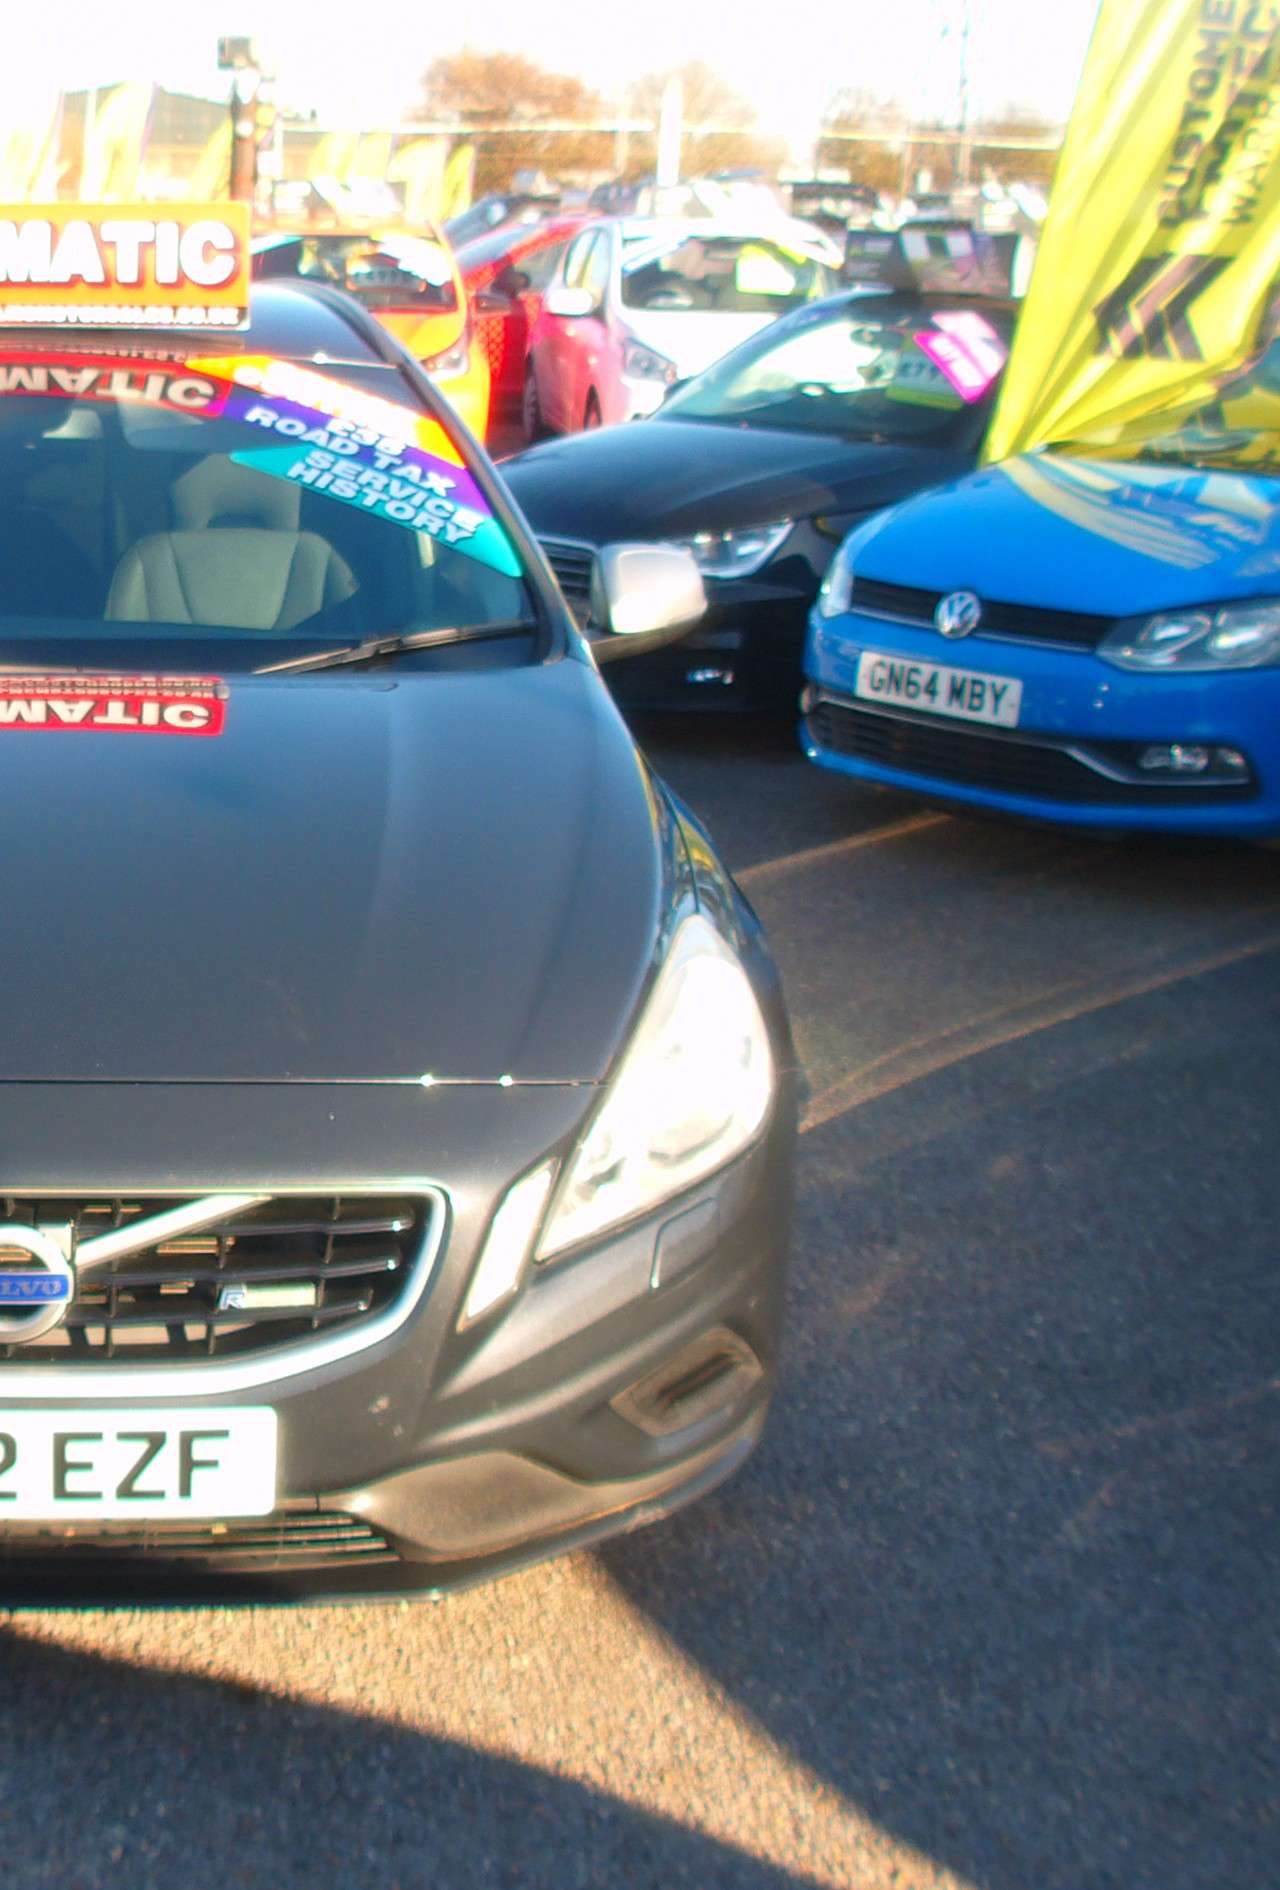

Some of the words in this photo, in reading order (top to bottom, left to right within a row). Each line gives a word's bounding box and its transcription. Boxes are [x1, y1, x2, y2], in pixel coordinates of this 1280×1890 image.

[244, 406, 359, 456] ROAD
[373, 452, 456, 497] TAX
[304, 449, 485, 531] SERVICE
[286, 461, 475, 544] HISTORY
[869, 659, 939, 703] GN64
[52, 1429, 231, 1500] EZF
